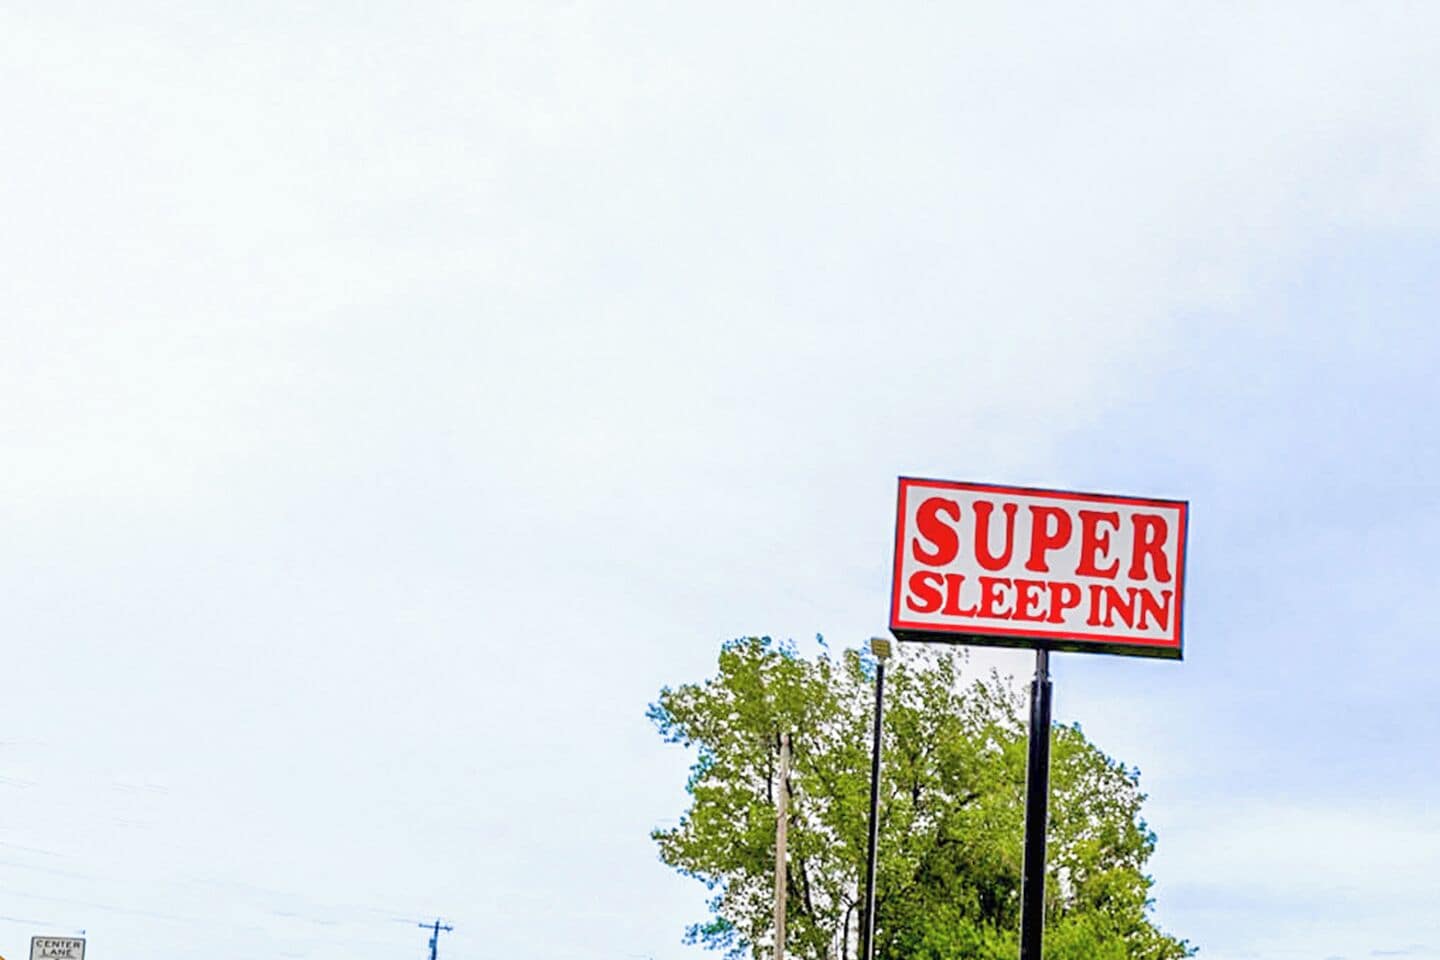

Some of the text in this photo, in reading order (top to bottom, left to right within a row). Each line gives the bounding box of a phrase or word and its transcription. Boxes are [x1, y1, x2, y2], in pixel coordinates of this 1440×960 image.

[912, 497, 1172, 583] SUPER
[36, 940, 81, 948] CENTER
[42, 948, 72, 956] LANE
